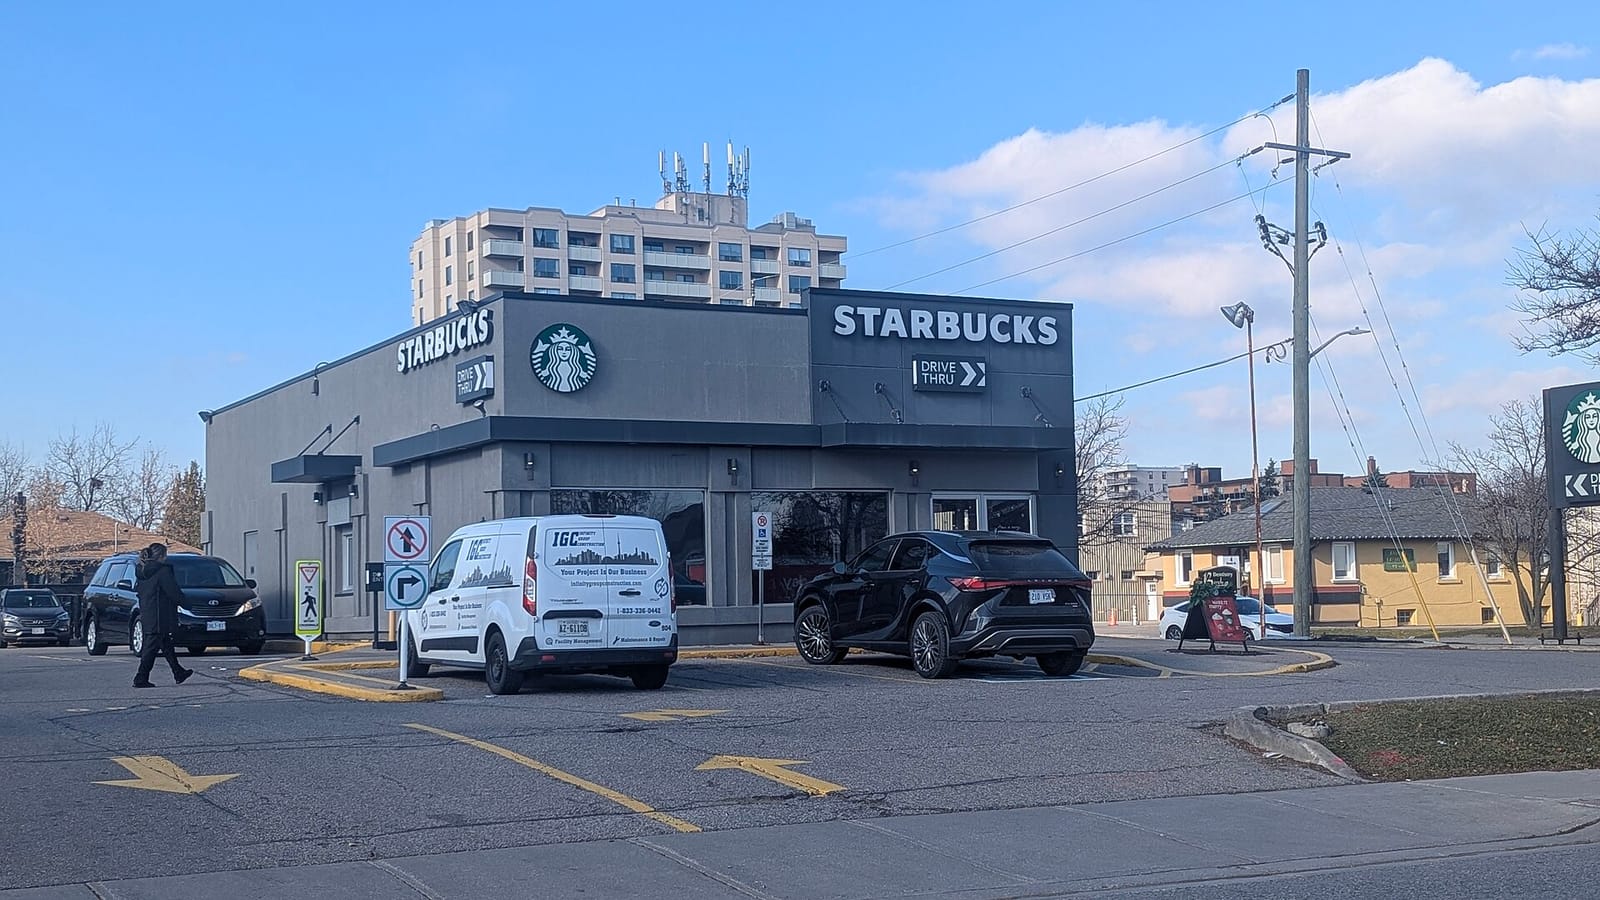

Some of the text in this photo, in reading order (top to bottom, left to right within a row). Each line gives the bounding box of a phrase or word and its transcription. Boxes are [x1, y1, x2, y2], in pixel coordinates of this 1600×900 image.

[834, 305, 1058, 345] STARBUCKS
[397, 308, 490, 373] STARBUCKS
[921, 360, 956, 373] DRIVE
[457, 366, 474, 384] DRIVE
[921, 373, 954, 385] THRU
[457, 381, 474, 396] THRU
[552, 531, 579, 547] IGC
[577, 568, 599, 577] Project
